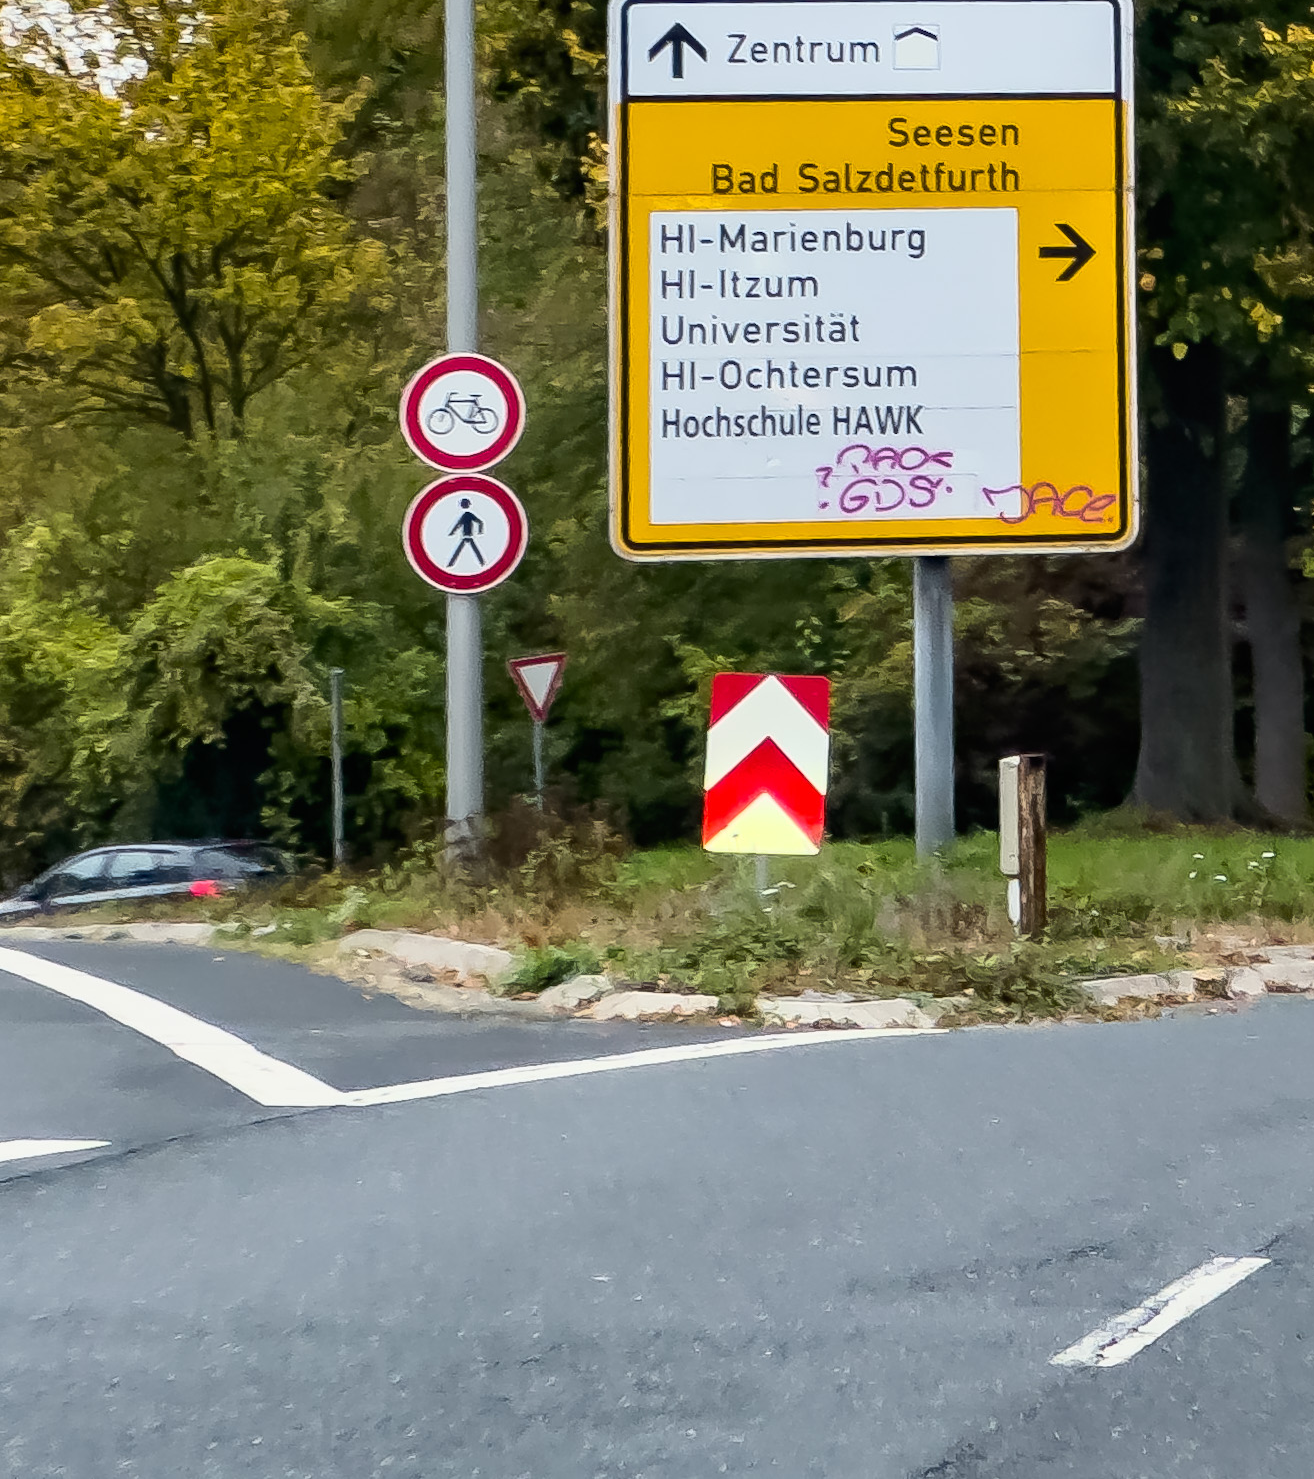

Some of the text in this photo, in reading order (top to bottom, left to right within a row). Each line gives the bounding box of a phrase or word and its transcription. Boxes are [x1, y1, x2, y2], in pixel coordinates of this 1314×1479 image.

[727, 33, 880, 64] Zentrum
[887, 117, 1020, 148] Seesen
[711, 162, 1021, 195] Bad Salzdetfurth
[660, 222, 927, 258] HI-Marienburg
[660, 269, 819, 300] HI-Itzum
[660, 312, 860, 345] Universität
[660, 359, 918, 391] HI-Ochtersum
[660, 405, 924, 439] Hochschule HAWK
